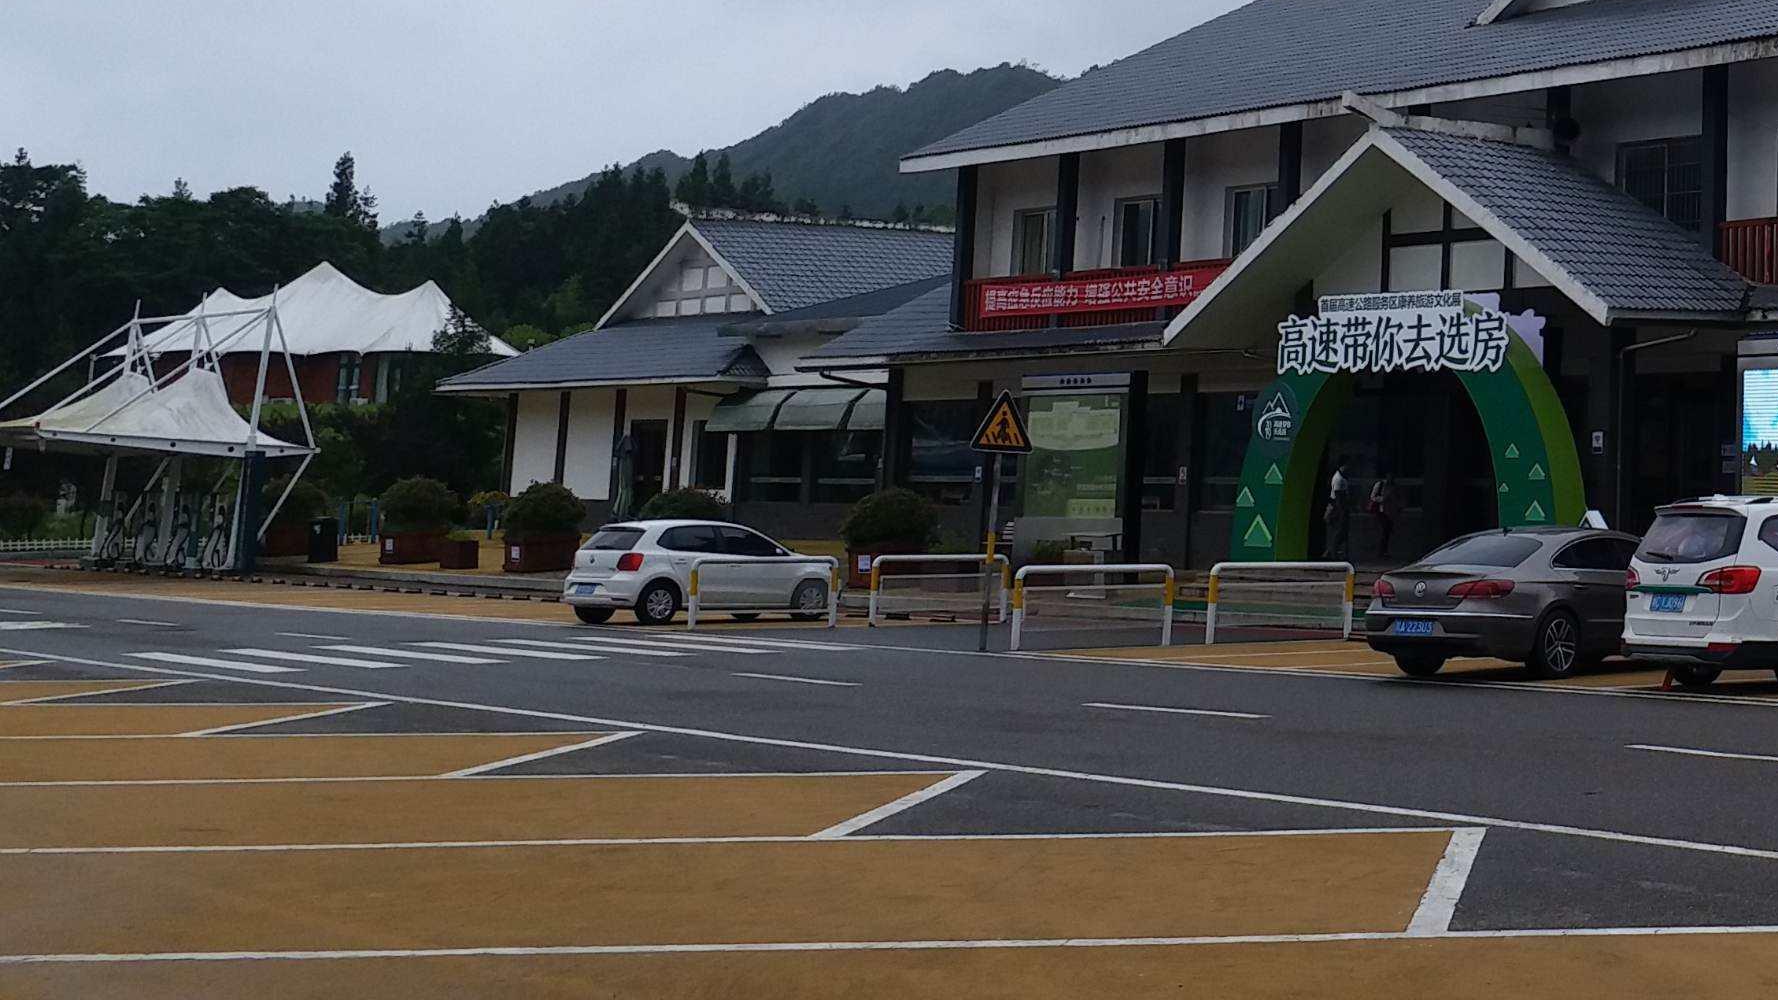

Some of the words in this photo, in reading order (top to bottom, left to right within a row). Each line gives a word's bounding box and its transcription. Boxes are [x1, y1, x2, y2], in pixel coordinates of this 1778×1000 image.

[984, 285, 1079, 312] 提高应急反应能力
[1084, 275, 1193, 306] 增强公共安全意识
[1320, 293, 1462, 313] 首届高速公路服务区康养旅游文化展
[1278, 311, 1507, 370] 高速带你去选房
